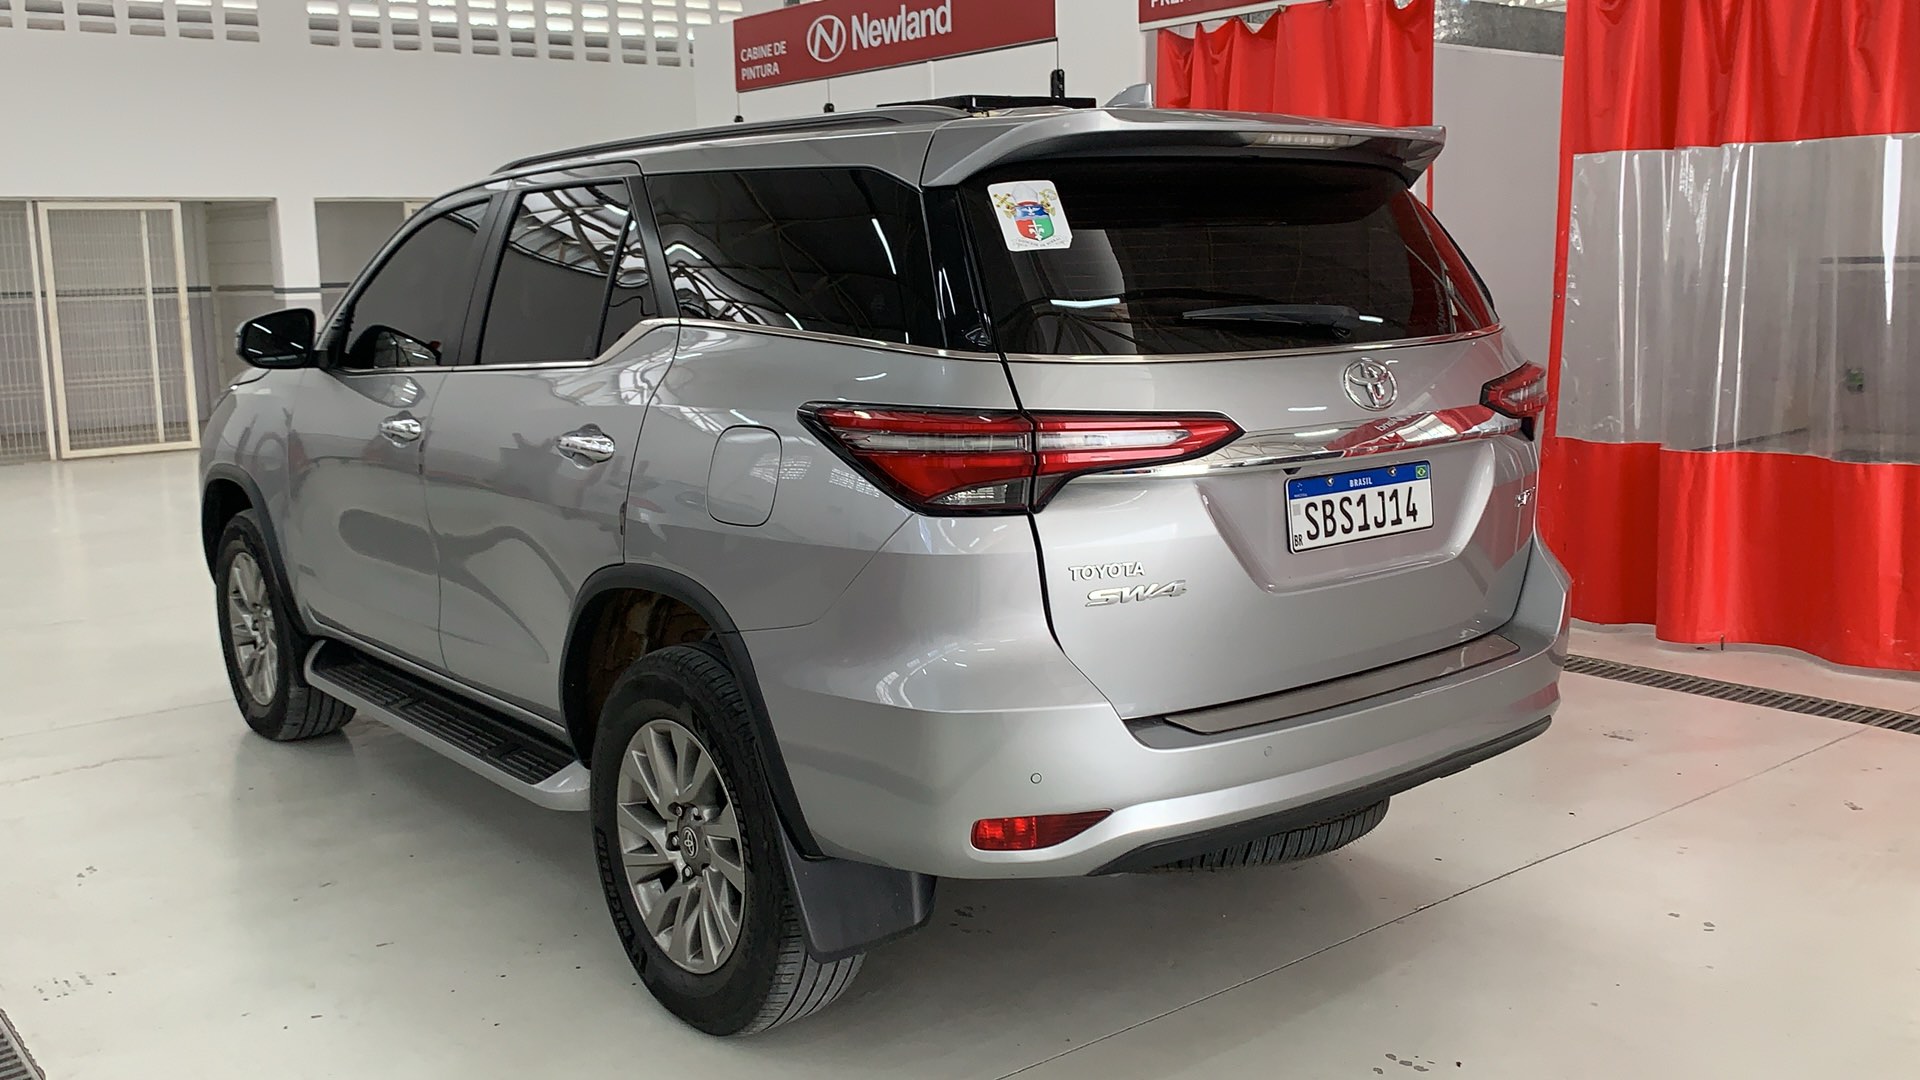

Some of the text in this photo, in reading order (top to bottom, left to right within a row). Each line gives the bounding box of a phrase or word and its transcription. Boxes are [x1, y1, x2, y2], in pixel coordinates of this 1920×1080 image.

[851, 0, 952, 50] Newland
[740, 41, 787, 62] CABINE DE
[741, 62, 779, 81] PINTURA
[1349, 477, 1373, 487] BRASIL
[1305, 486, 1418, 540] SBS1J14
[1294, 534, 1303, 547] BR
[1068, 562, 1145, 581] TOYOTA
[1085, 580, 1187, 607] SW4
